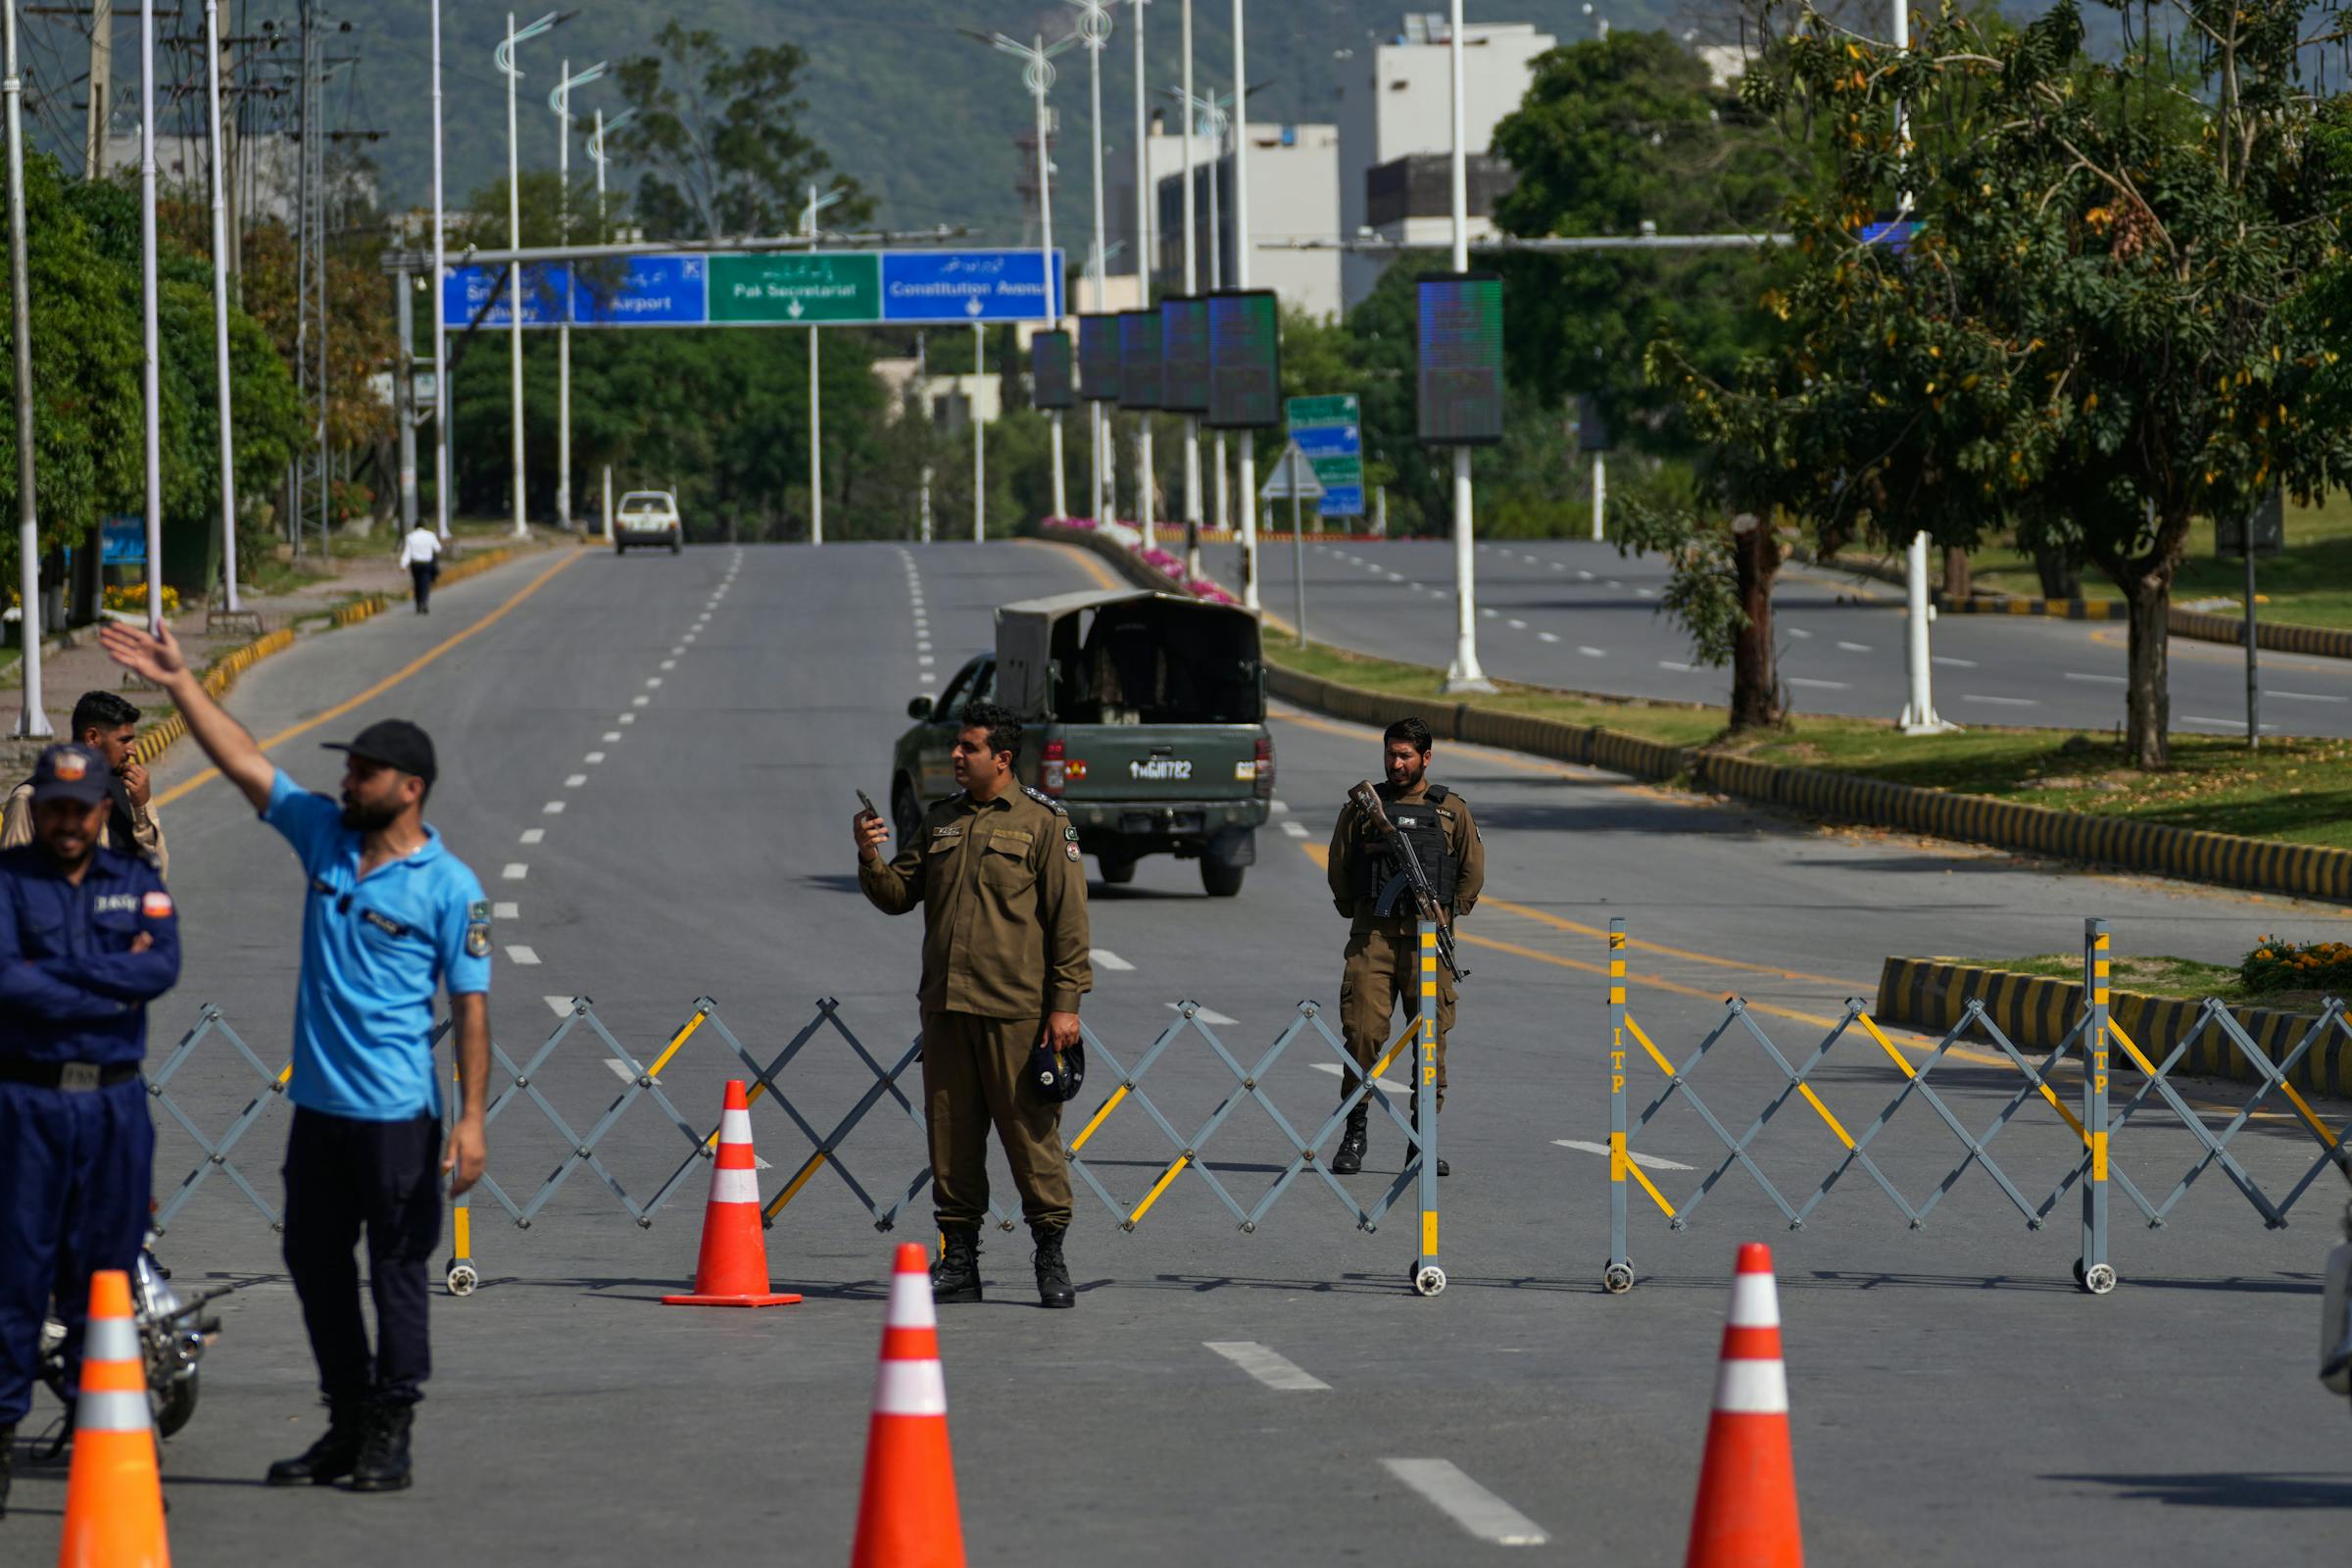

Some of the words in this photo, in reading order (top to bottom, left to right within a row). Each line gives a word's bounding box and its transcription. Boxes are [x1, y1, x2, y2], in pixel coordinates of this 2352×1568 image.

[889, 280, 992, 297] Constitution
[995, 280, 1046, 296] Avenu
[1422, 1018, 1438, 1086] ITP
[1610, 1027, 1626, 1094] ITP
[2093, 1027, 2108, 1094] ITP
